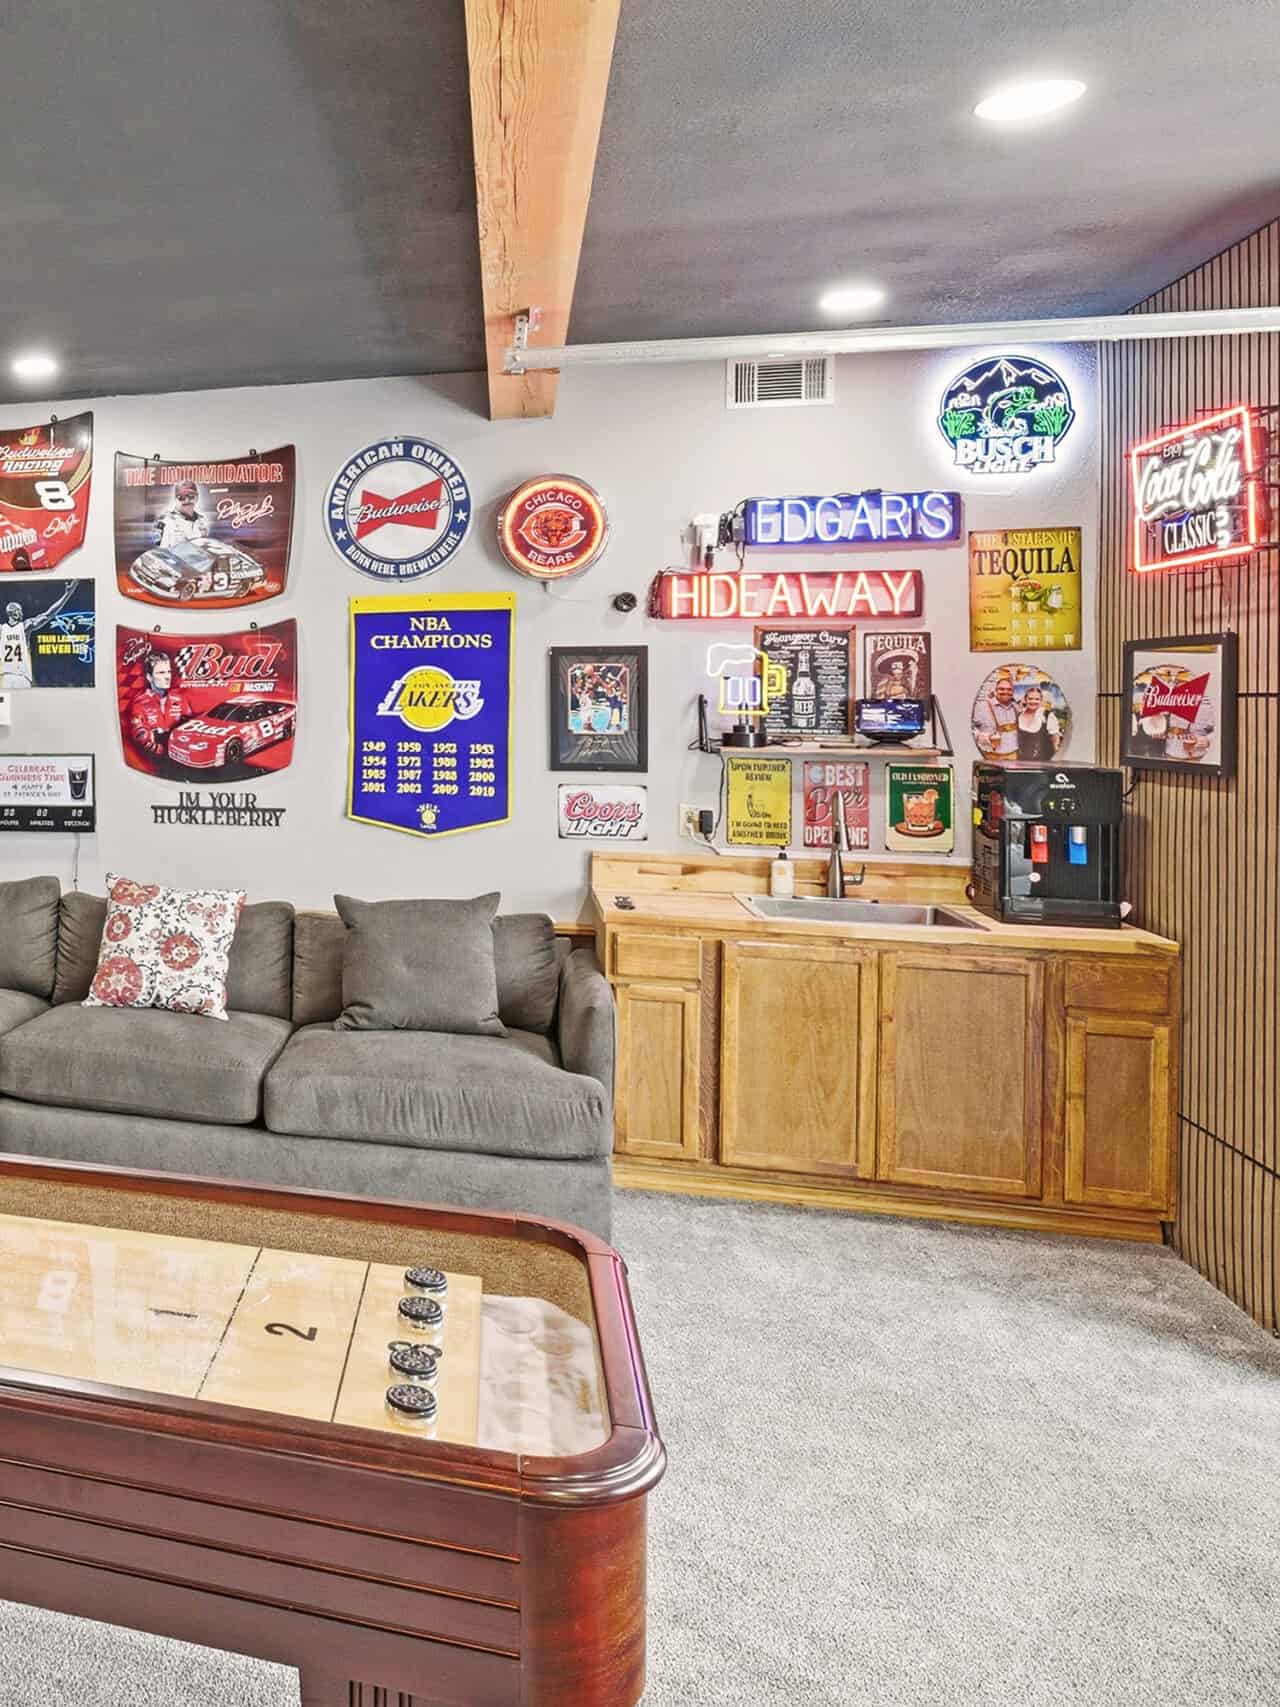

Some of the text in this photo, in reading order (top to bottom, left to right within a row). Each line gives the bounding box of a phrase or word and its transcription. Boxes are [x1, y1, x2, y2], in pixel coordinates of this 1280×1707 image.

[954, 435, 1056, 465] BUSCH
[2, 459, 65, 473] RACING
[160, 463, 284, 486] INTIMIDATOR
[969, 458, 1035, 473] LIGHT
[125, 467, 156, 487] THE
[330, 442, 404, 521] AMERICAN
[411, 444, 467, 502] OWNED
[34, 481, 76, 511] 8
[524, 490, 583, 511] CHICAGO
[348, 497, 450, 525] Budweiser
[756, 493, 952, 543] EDGAR'S
[1012, 532, 1058, 545] STAGES
[1060, 530, 1075, 545] OF
[1164, 510, 1217, 554] CLASSIC
[345, 543, 371, 568] BORN
[399, 552, 441, 576] BREWED
[527, 549, 575, 566] BEARS
[972, 546, 1077, 580] TEQUILA
[213, 572, 231, 591] 3
[671, 571, 913, 618] HIDEAWAY
[409, 616, 452, 631] NBA
[370, 633, 493, 649] CHAMPIONS
[763, 631, 817, 646] Hangover
[868, 635, 927, 653] TEQUILA
[4, 644, 23, 662] 24
[38, 643, 72, 655] NEVER
[190, 643, 283, 681] Bud
[380, 681, 480, 716] LAKERS
[1144, 685, 1204, 708] Budweiser
[180, 719, 236, 736] Bud
[258, 719, 274, 738] 8
[825, 765, 864, 786] BEST
[432, 784, 457, 795] 2009
[469, 785, 494, 796] 2010
[208, 792, 257, 809] YOUR
[564, 790, 643, 822] Coors
[152, 807, 283, 827] HUCKLEBERRY
[566, 819, 638, 837] LIGHT
[264, 1322, 318, 1342] 2
